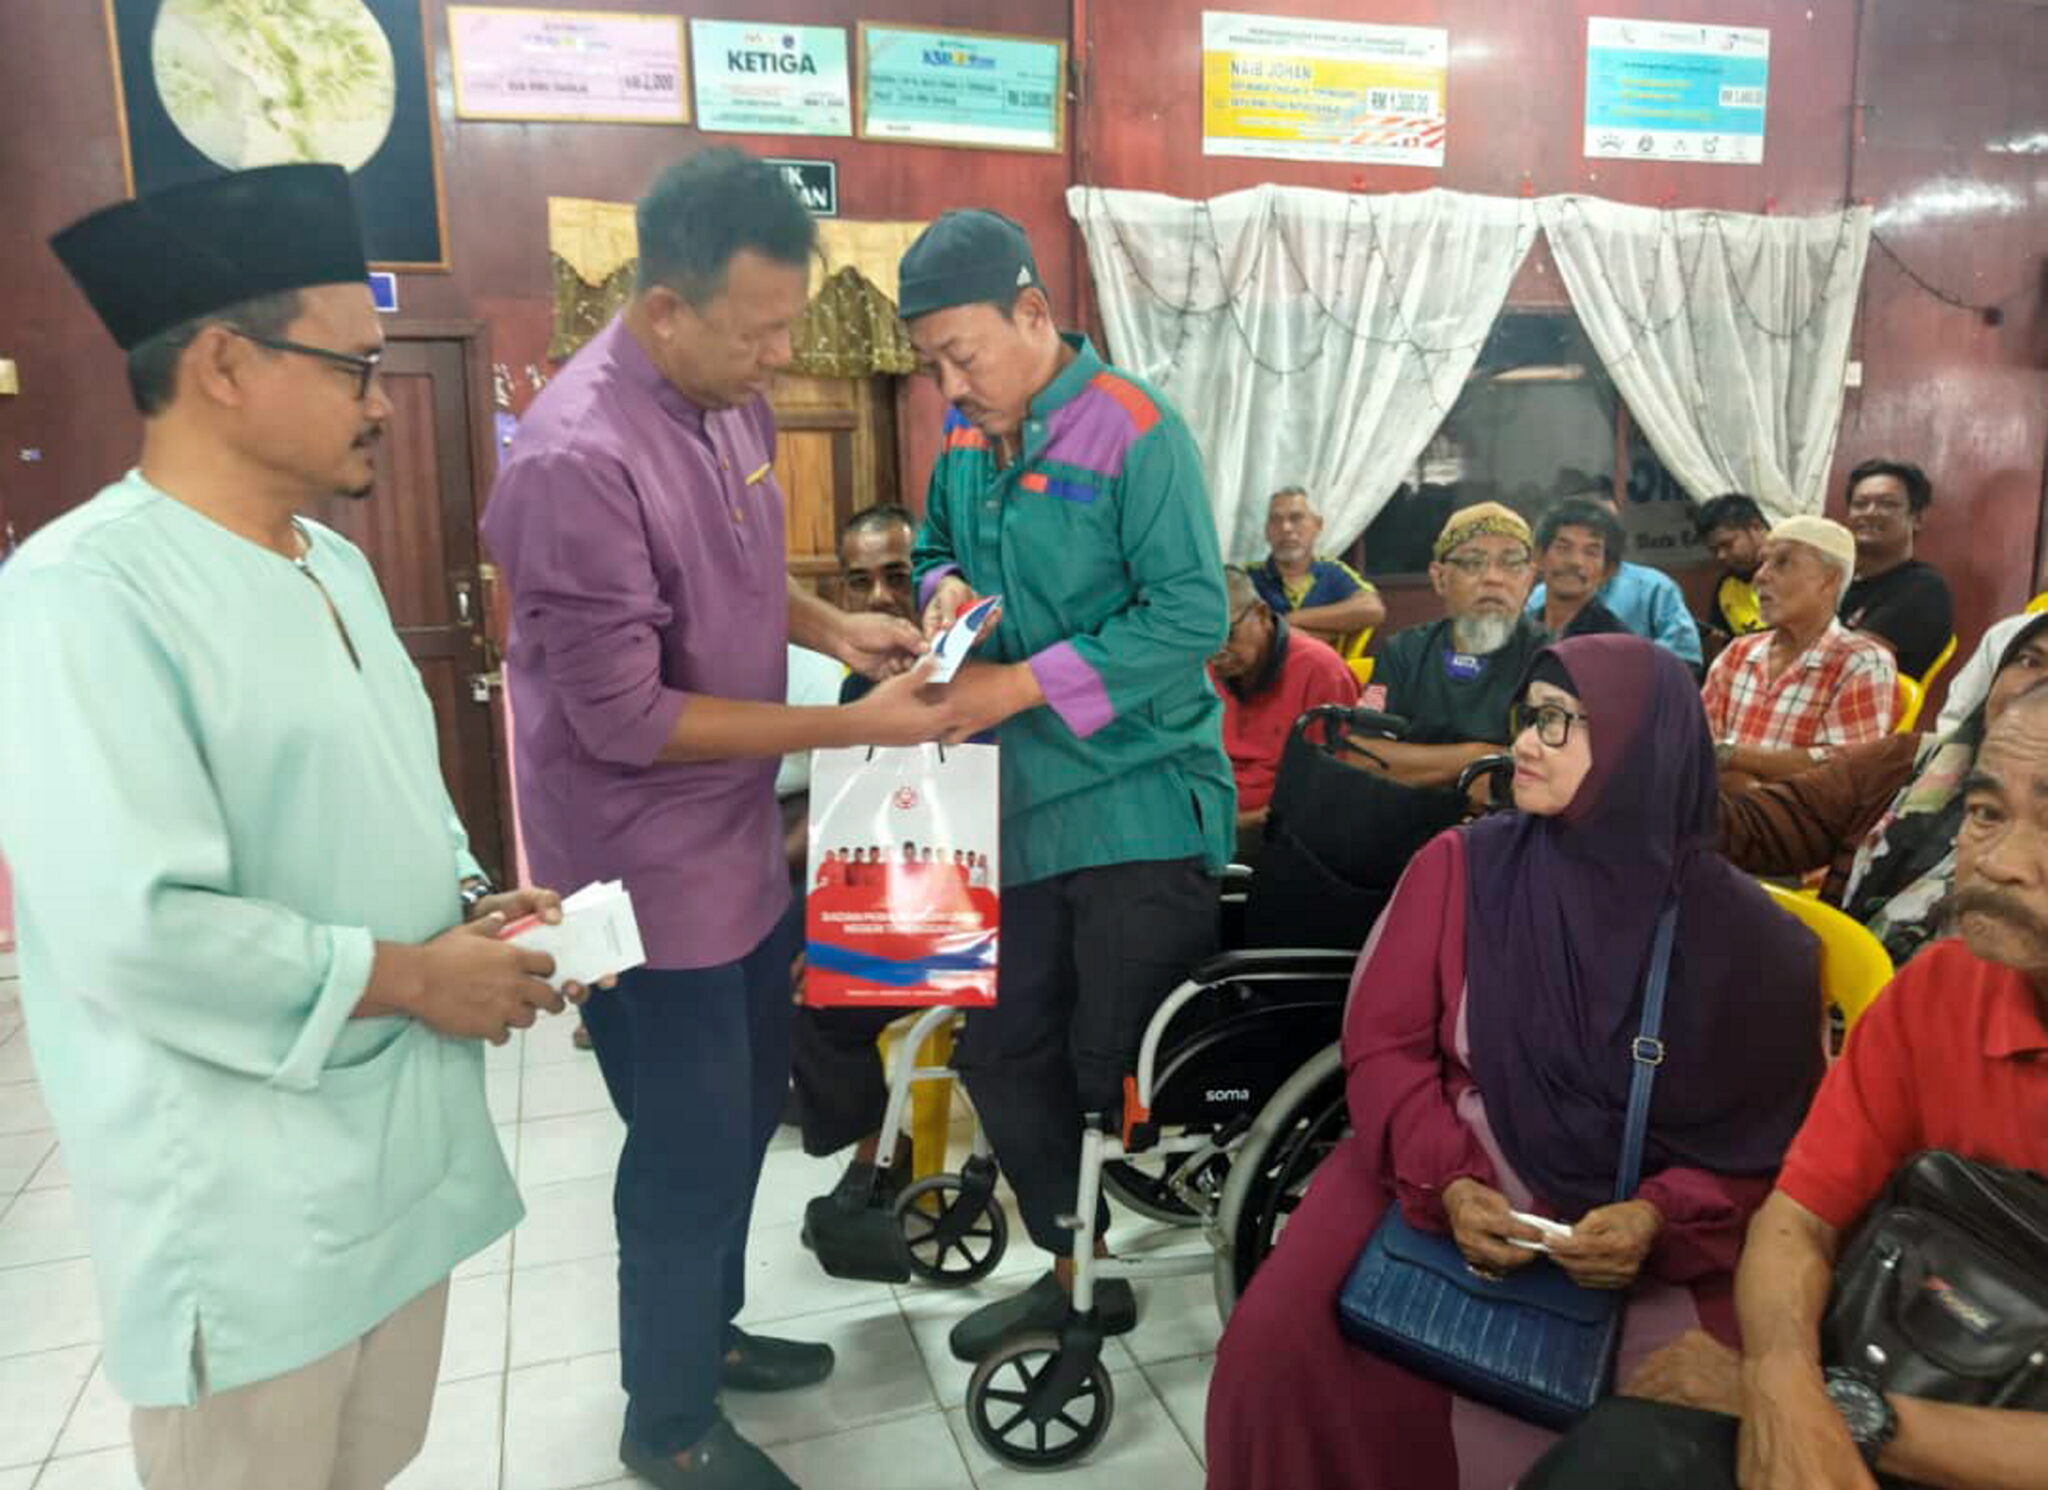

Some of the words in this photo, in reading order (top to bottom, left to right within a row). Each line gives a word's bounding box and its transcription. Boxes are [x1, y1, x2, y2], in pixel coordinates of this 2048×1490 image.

[727, 49, 818, 76] KETIGA
[1231, 60, 1262, 76] NAIB
[1267, 62, 1313, 80] JOHAN
[1371, 90, 1388, 109] RM
[1205, 1089, 1250, 1102] soma
